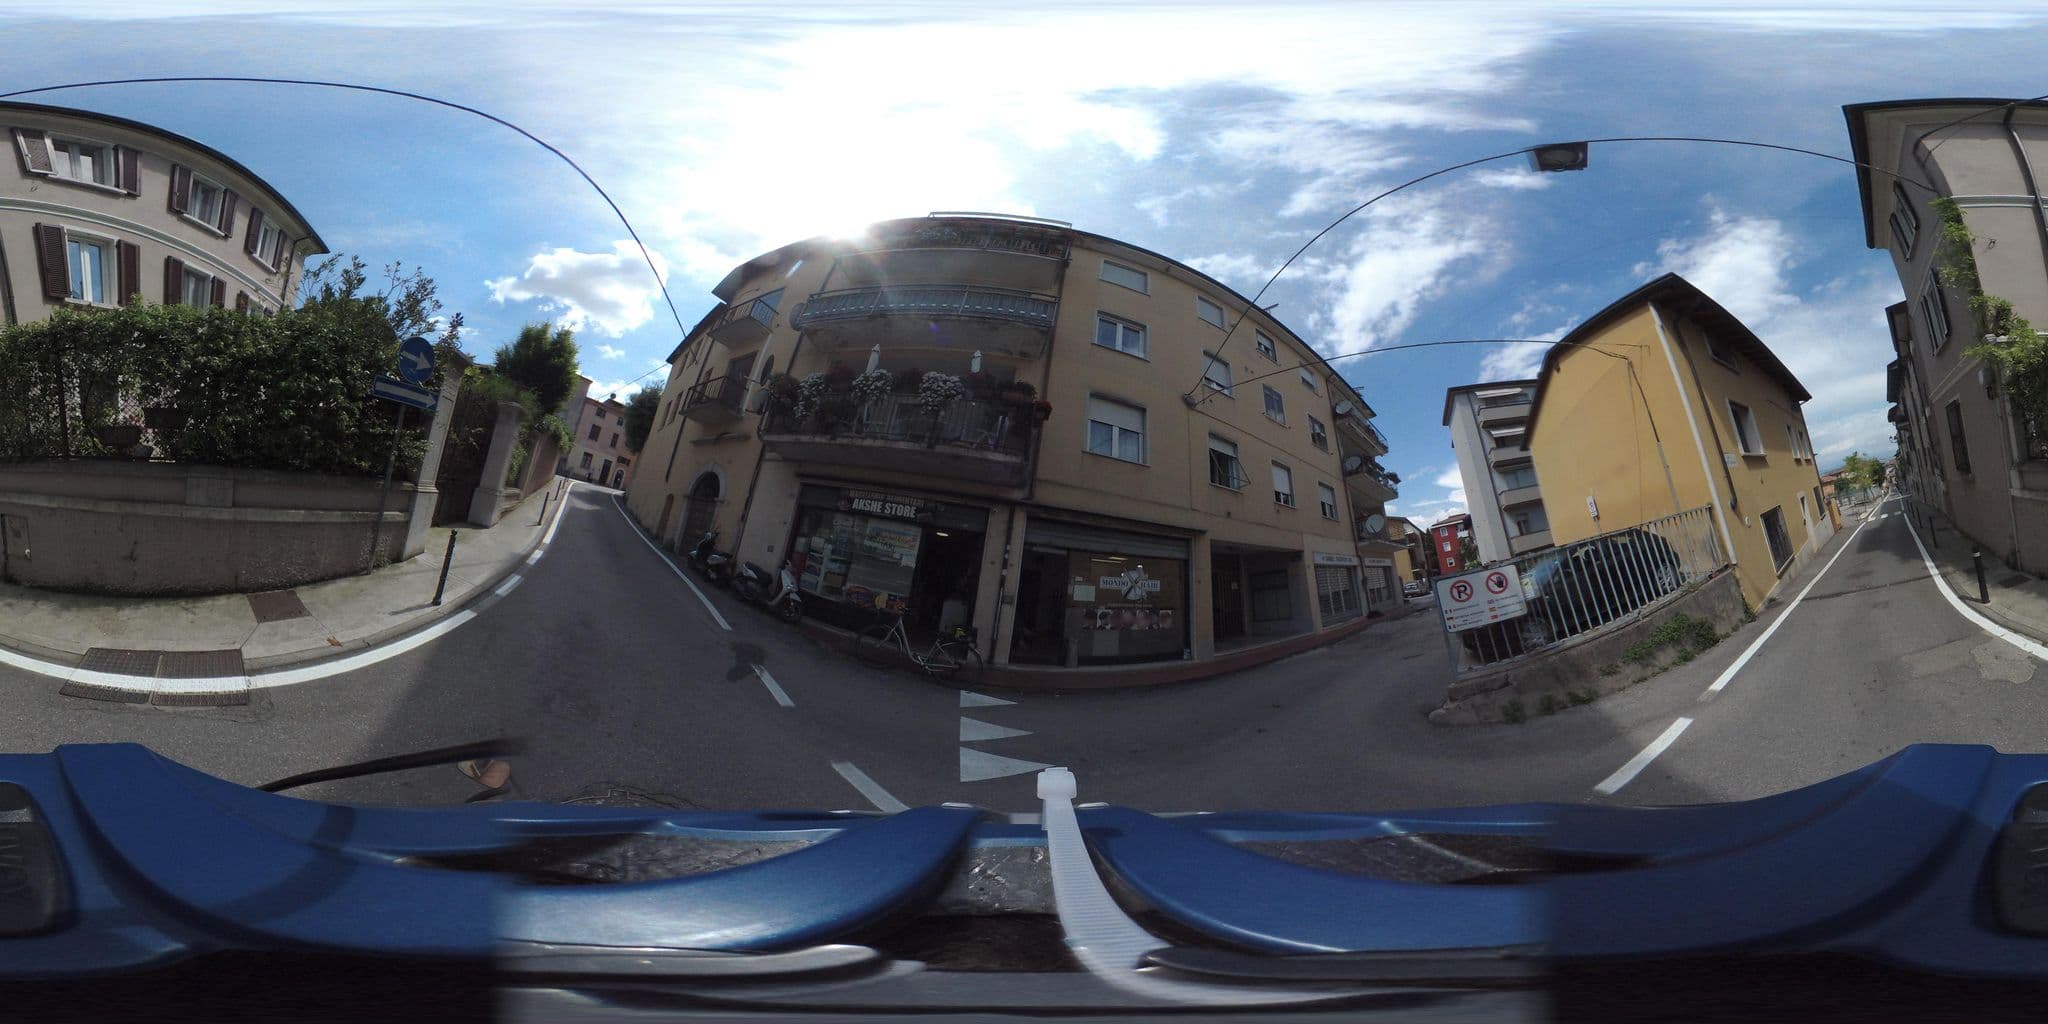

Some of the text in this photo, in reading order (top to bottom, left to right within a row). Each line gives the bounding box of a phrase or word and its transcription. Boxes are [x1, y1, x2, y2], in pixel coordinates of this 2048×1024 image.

[852, 498, 918, 518] AKSHE STORE
[1102, 578, 1129, 587] MONDO
